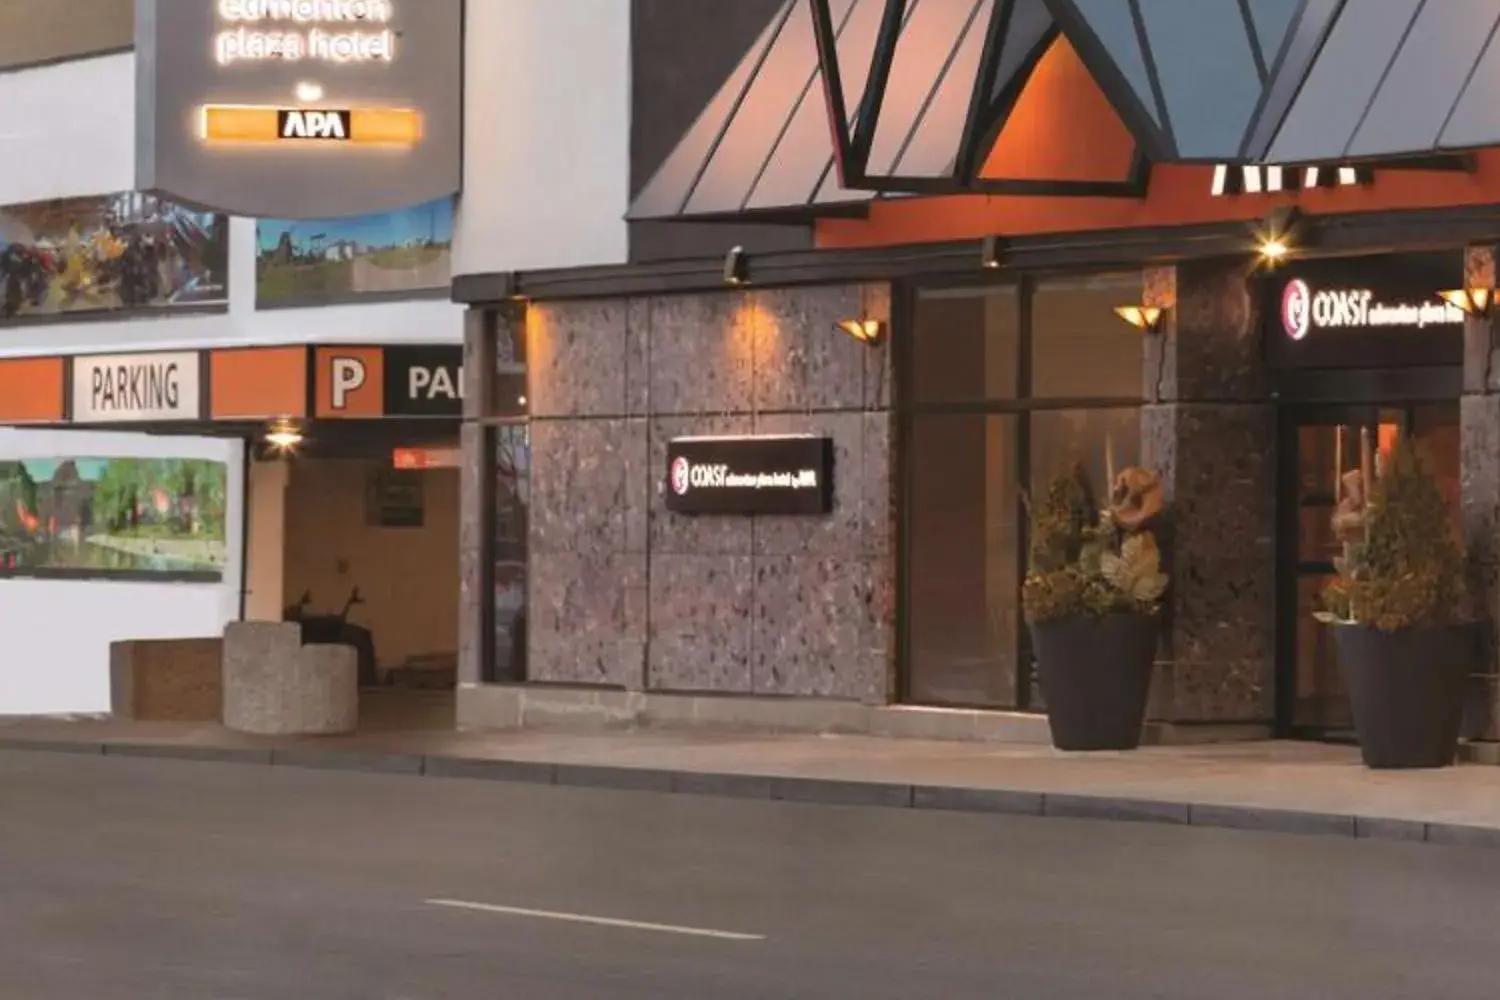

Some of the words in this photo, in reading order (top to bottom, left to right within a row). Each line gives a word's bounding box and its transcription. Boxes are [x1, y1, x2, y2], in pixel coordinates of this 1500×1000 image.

[214, 27, 303, 66] plaza
[308, 27, 394, 62] hotel
[283, 111, 345, 138] APA
[1312, 288, 1372, 328] COAST
[91, 361, 179, 411] PARKING
[332, 357, 366, 408] P
[690, 463, 729, 488] COAST
